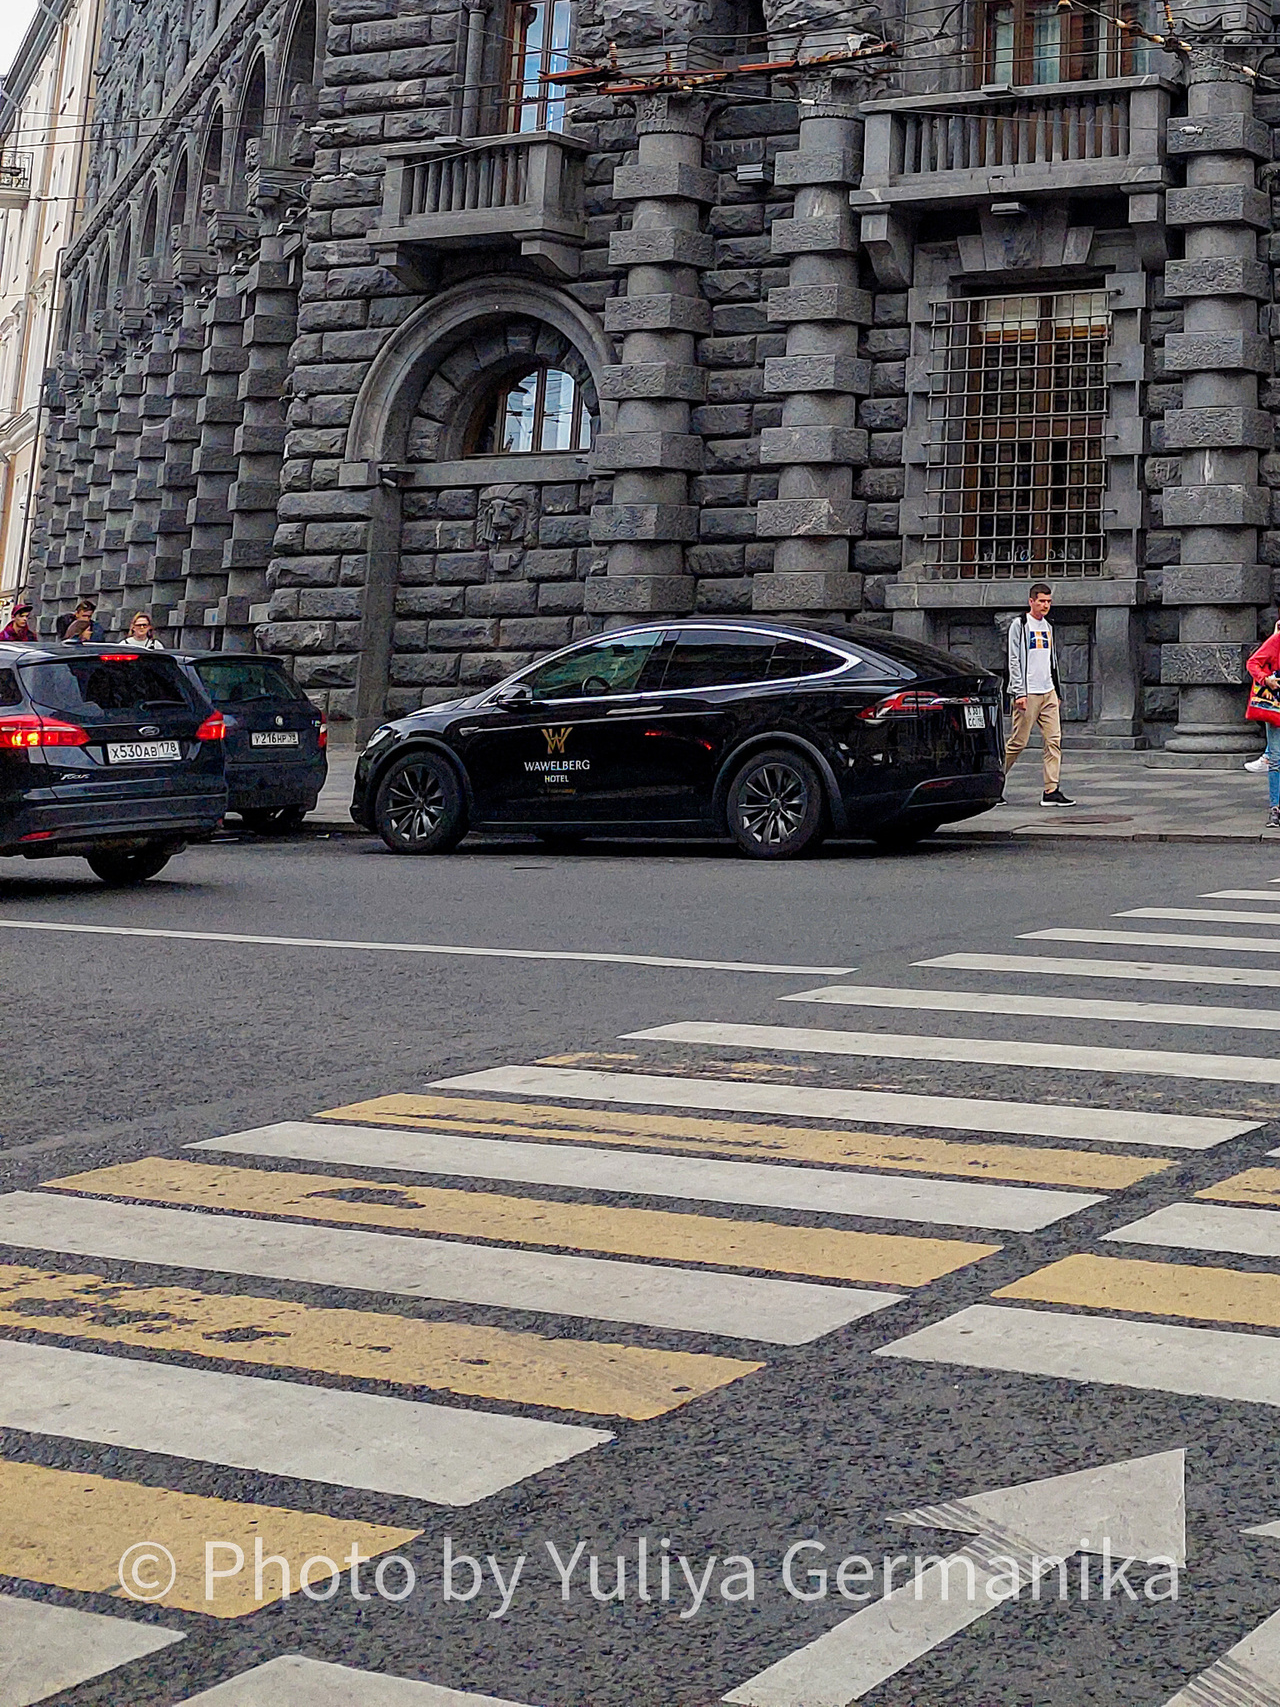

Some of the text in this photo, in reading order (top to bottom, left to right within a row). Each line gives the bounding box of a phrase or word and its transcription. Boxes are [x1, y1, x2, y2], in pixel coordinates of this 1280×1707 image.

[159, 742, 177, 753] 178
[524, 759, 590, 771] WAWELBERG
[544, 775, 569, 783] HOTEL
